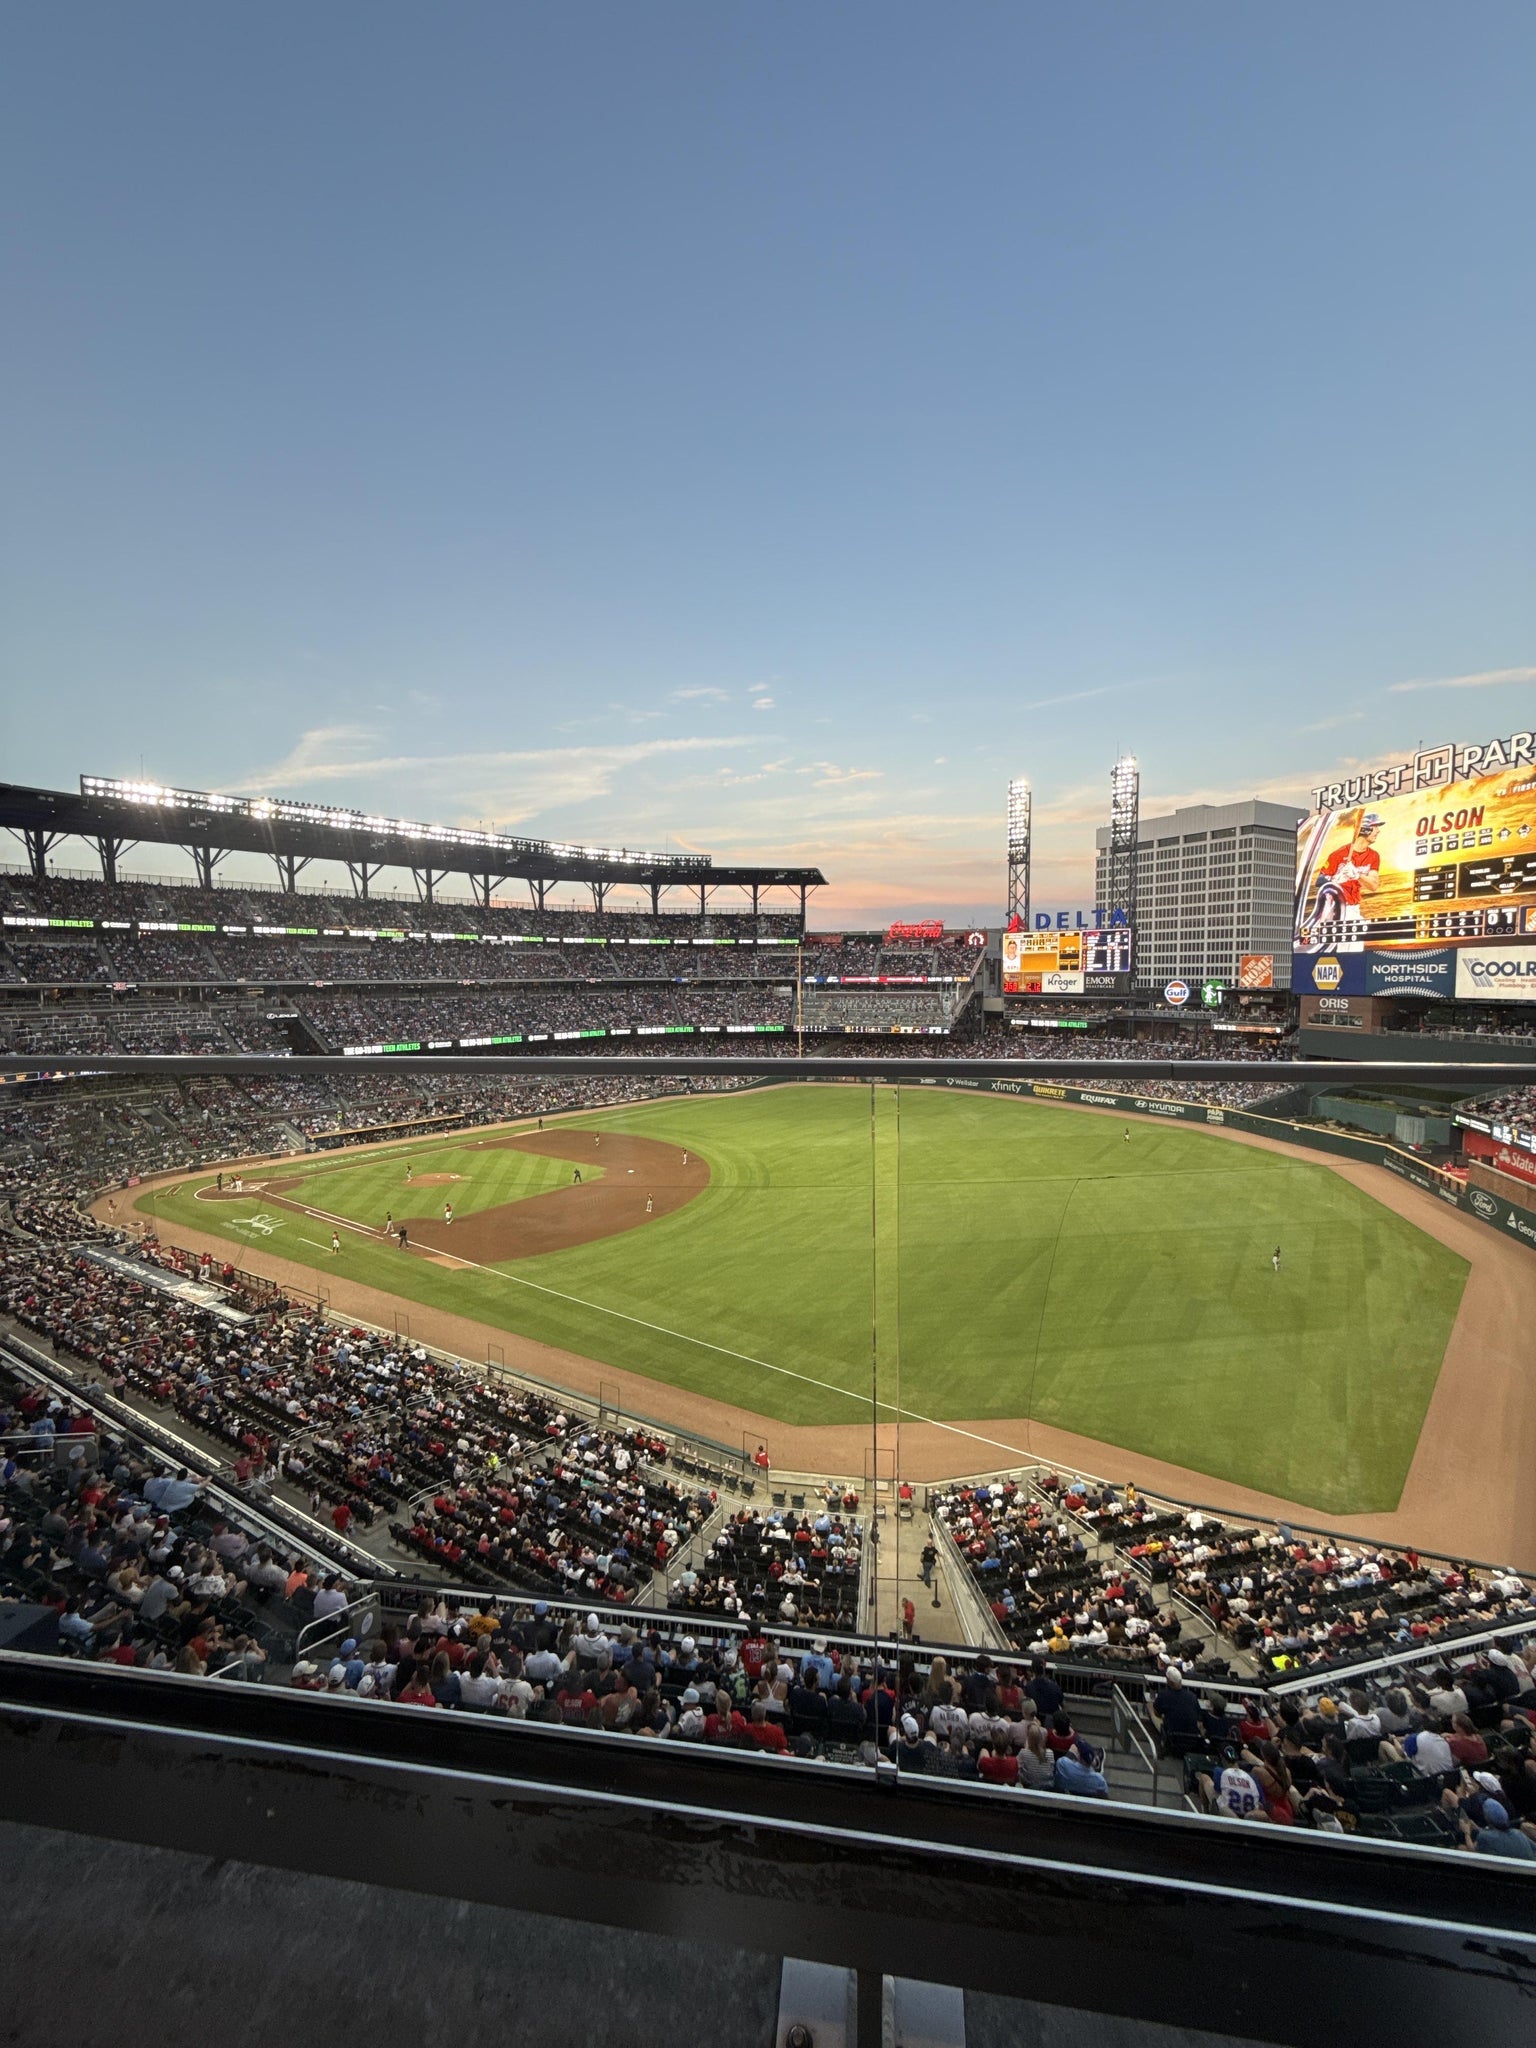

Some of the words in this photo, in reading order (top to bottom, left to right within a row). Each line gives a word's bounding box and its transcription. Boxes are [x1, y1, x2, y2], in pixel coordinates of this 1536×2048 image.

[1311, 764, 1408, 809] TRUIST
[1415, 805, 1485, 837] OLSON
[2, 916, 17, 925] THE
[17, 917, 36, 926] GO-TO
[36, 918, 49, 926] FOR
[49, 919, 64, 927] TEEN
[64, 920, 94, 928] ATHLETES
[1035, 908, 1128, 930] DELTA
[1459, 918, 1466, 926] 2
[1488, 913, 1499, 925] 0
[1505, 912, 1513, 924] 1
[889, 919, 944, 939] Coca-Cola
[1445, 929, 1452, 937] 0
[1241, 956, 1271, 987] HOME
[1243, 959, 1258, 971] THE
[1372, 963, 1448, 975] NORTHSIDE
[1253, 967, 1272, 986] DEPOT
[1316, 965, 1339, 981] NAPA
[1384, 975, 1433, 983] HOSPITAL
[1048, 974, 1077, 991] Kroger
[1085, 976, 1116, 985] EMORY
[1166, 989, 1187, 997] Gulf
[1319, 998, 1349, 1009] ORIS
[343, 1047, 355, 1055] THE
[354, 1046, 371, 1055] GO-TO
[371, 1045, 383, 1053] FOR
[383, 1044, 395, 1052] TEEN
[395, 1043, 420, 1051] ATHLETES
[955, 1079, 979, 1087] Wellstar
[991, 1081, 1022, 1094] xfinity
[1033, 1083, 1067, 1096] QUIKRETE
[1080, 1093, 1117, 1106] EQUIFAX
[1149, 1102, 1185, 1113] HYUNDAI
[1511, 1152, 1534, 1173] State
[1474, 1193, 1493, 1212] Ford
[1227, 1775, 1250, 1789] OLSON
[1229, 1790, 1256, 1813] 28
